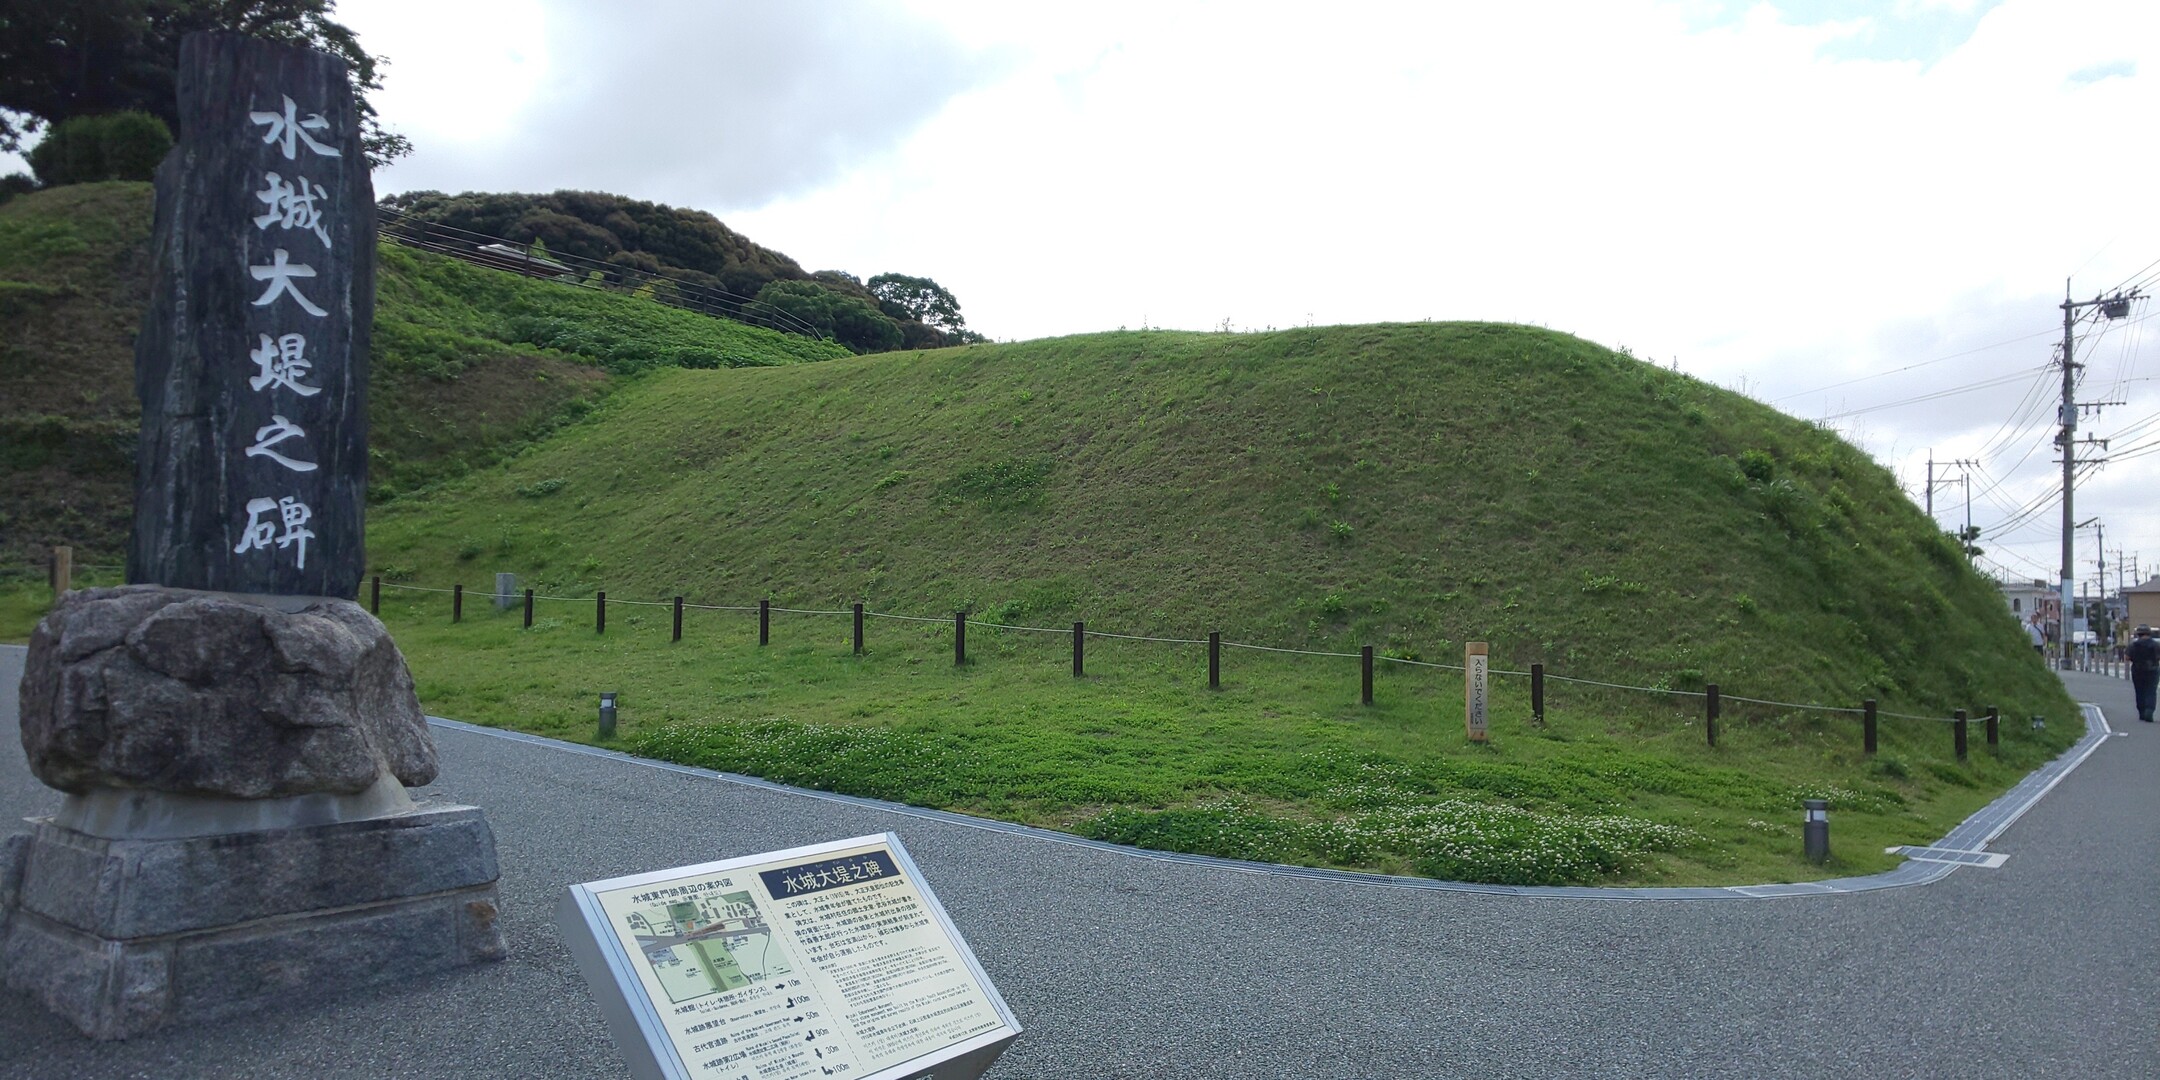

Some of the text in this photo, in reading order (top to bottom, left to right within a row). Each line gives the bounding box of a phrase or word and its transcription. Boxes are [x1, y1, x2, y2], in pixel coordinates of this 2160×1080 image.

[233, 92, 343, 570] 水城大堤之碑
[1474, 659, 1483, 725] 入らないでください
[783, 860, 882, 892] 水城大堤之碑
[632, 878, 732, 903] 水城東門跡周辺の案内図
[787, 978, 801, 987] 10m
[793, 995, 810, 1004] 100m
[805, 1011, 820, 1020] 50m
[684, 1018, 726, 1035] 水城跡展望台
[815, 1028, 829, 1037] 90m
[693, 1037, 728, 1053] 古代官道跡
[825, 1045, 839, 1054] 30m
[703, 1050, 747, 1069] 水城跡第2広場
[715, 1062, 739, 1074] (トイレ)
[832, 1063, 850, 1073] 100m
